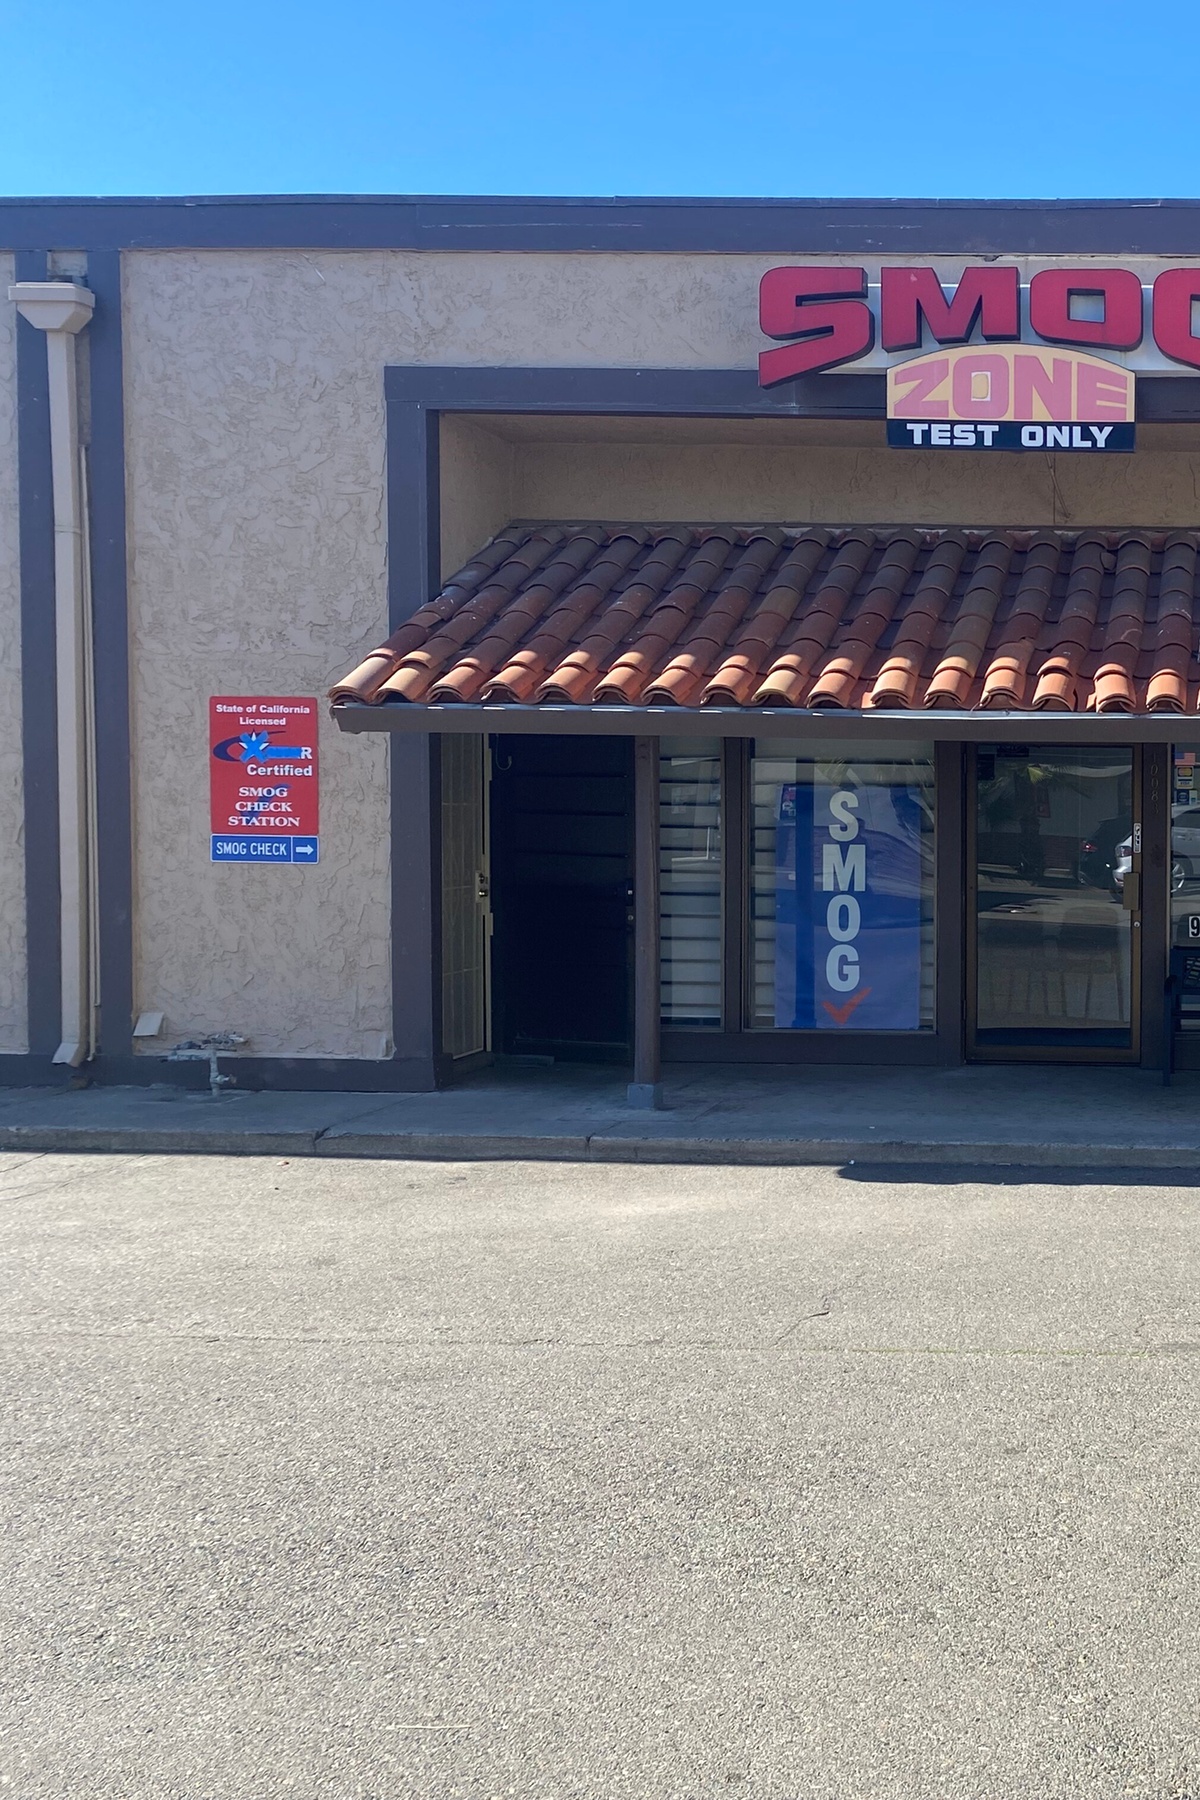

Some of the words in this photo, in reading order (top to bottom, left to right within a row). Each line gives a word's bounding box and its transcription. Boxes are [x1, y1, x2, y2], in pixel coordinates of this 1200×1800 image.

[893, 354, 1128, 421] ZONE
[906, 423, 1000, 447] TEST
[1021, 425, 1113, 448] ONLY
[216, 704, 243, 713] State
[246, 704, 257, 713] of
[259, 705, 310, 714] California
[239, 717, 286, 726] Licensed
[247, 765, 312, 776] Certified
[238, 787, 288, 797] SMOG
[235, 802, 292, 812] CHECK
[228, 816, 300, 827] STATION
[216, 842, 247, 855] SMOG
[250, 843, 287, 856] CHECK
[822, 791, 866, 992] SMOG
